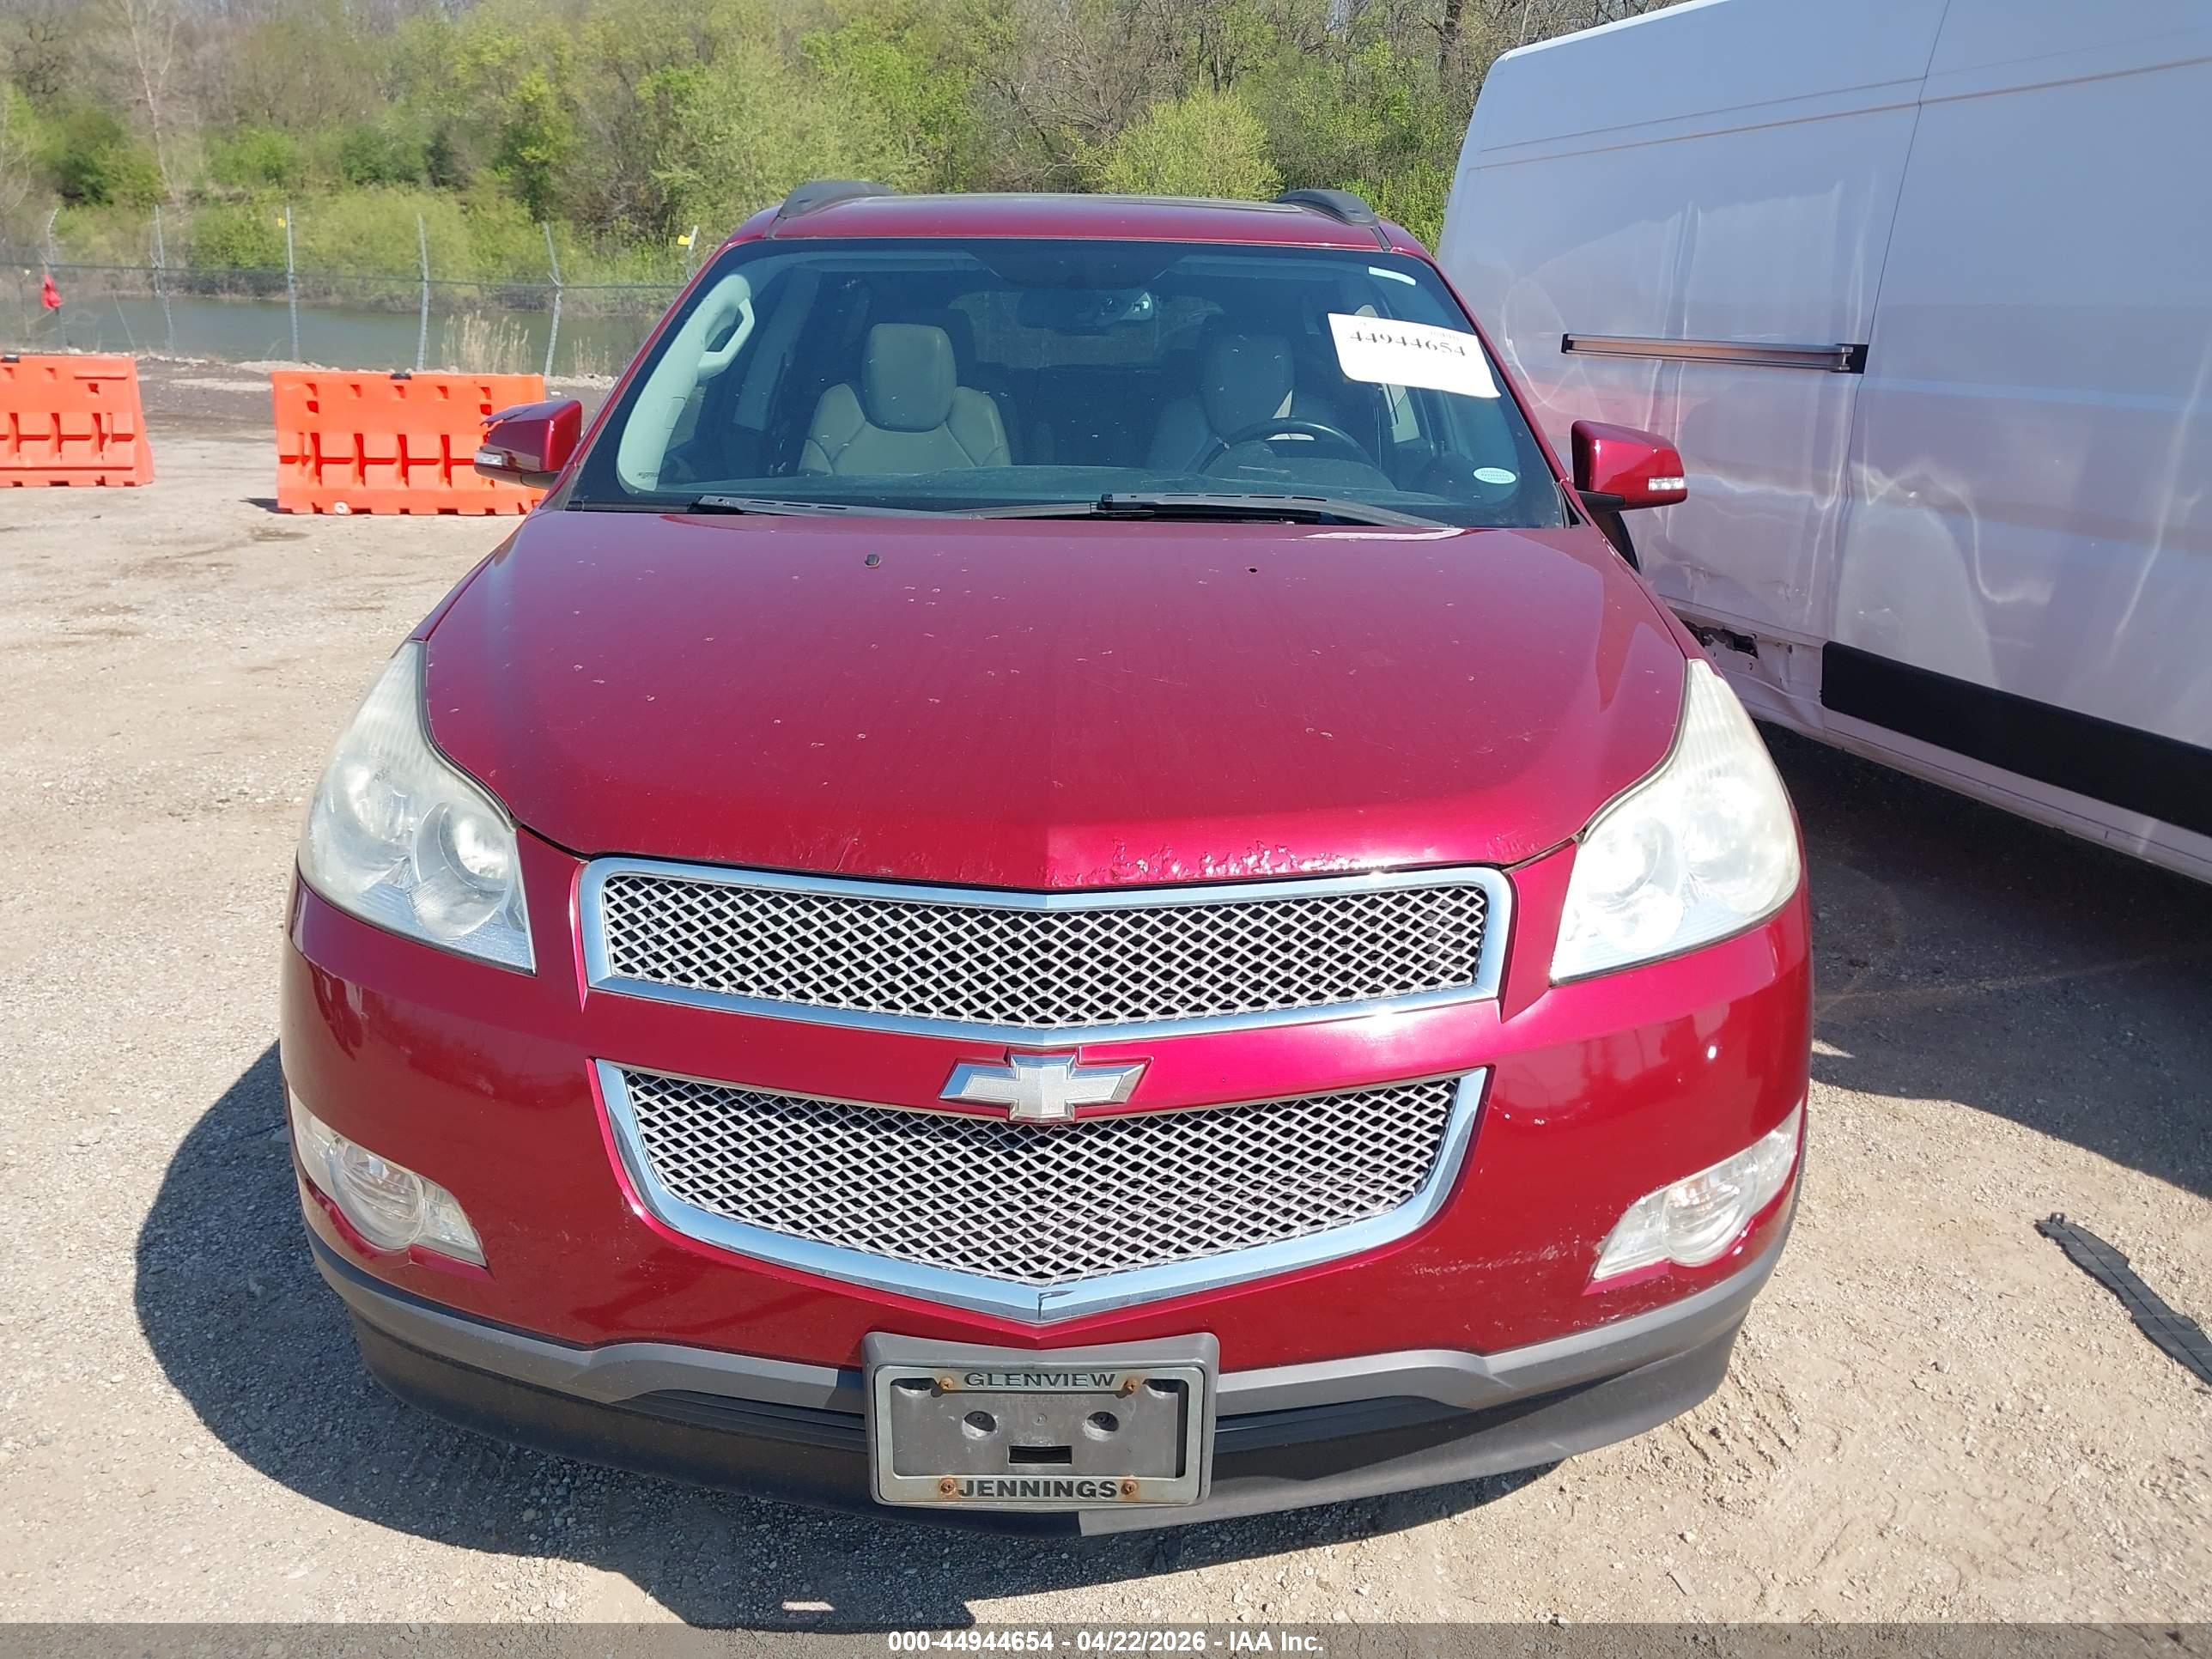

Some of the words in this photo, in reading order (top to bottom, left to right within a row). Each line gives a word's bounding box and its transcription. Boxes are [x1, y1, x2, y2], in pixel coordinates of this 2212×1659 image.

[1349, 331, 1466, 357] 44944654
[963, 1372, 1116, 1388] GLENVIEW
[958, 1480, 1117, 1500] JENNINGS
